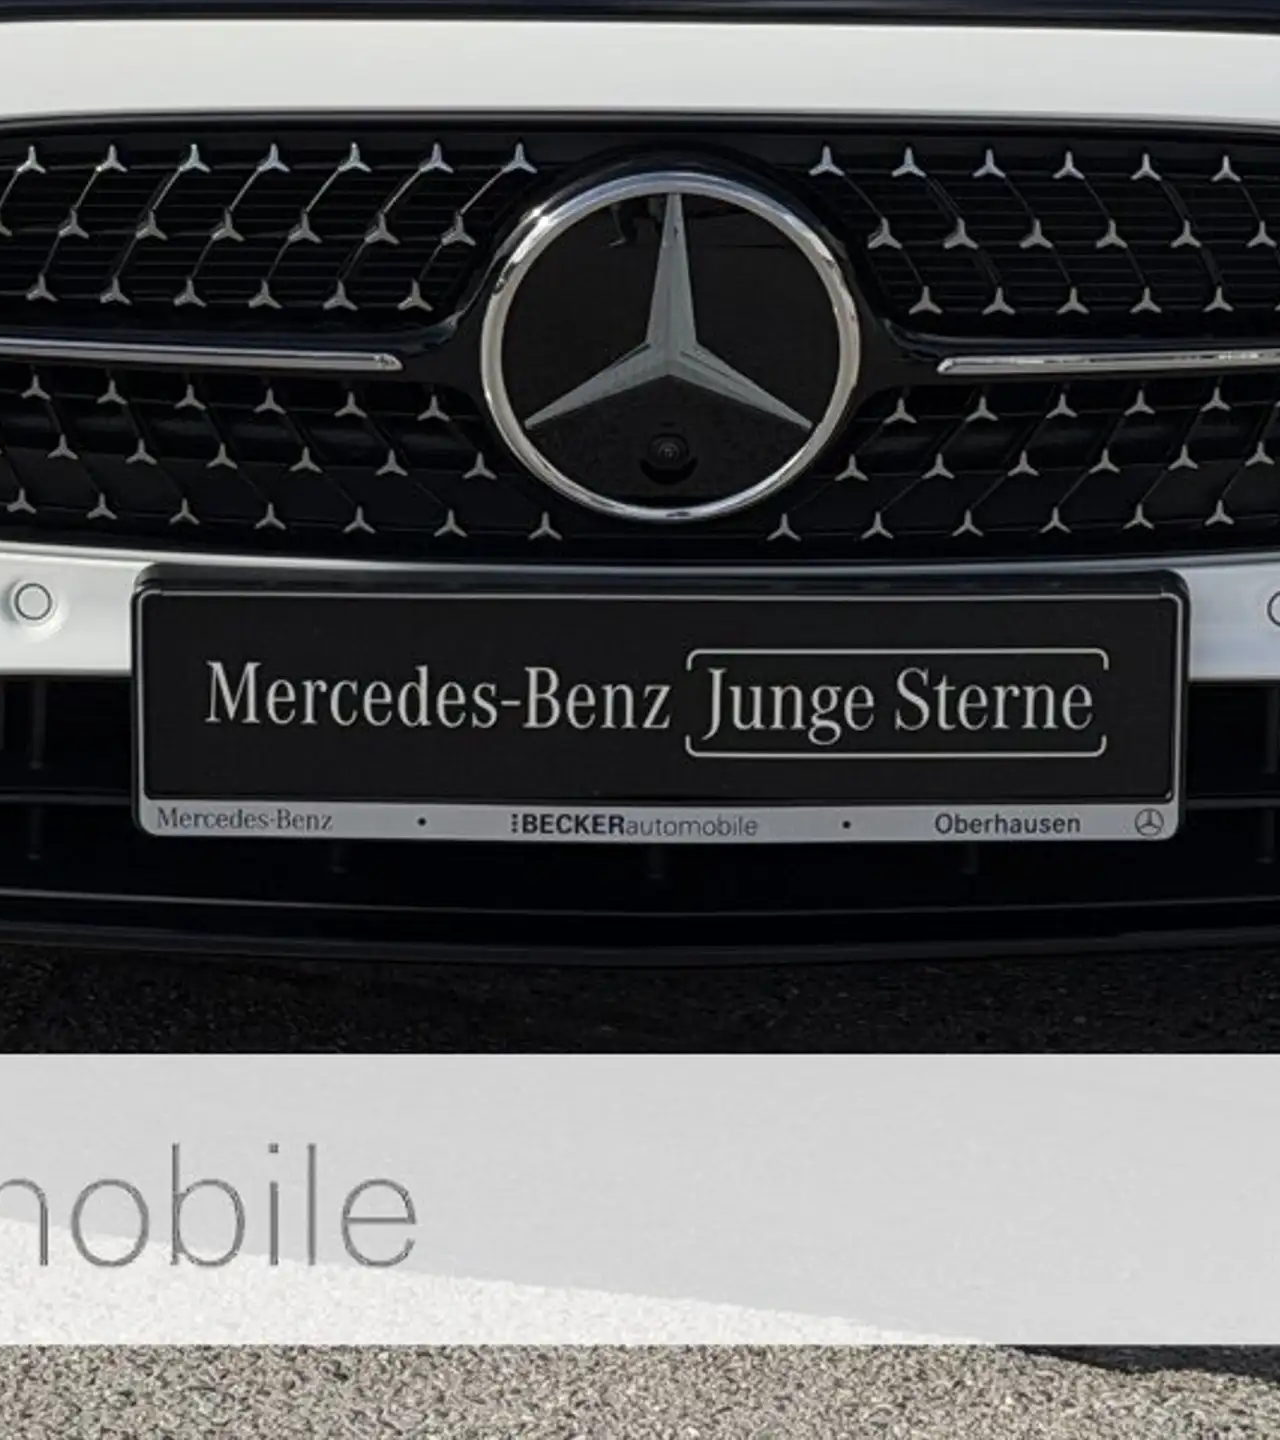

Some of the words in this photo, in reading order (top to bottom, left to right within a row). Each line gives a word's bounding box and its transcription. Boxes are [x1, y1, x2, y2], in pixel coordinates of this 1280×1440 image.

[205, 661, 671, 729] Mercedes-Benz
[703, 667, 875, 746] Junge
[894, 667, 1093, 731] Sterne
[156, 807, 333, 831] Mercedes-Benz
[934, 812, 1081, 835] Oberhausen
